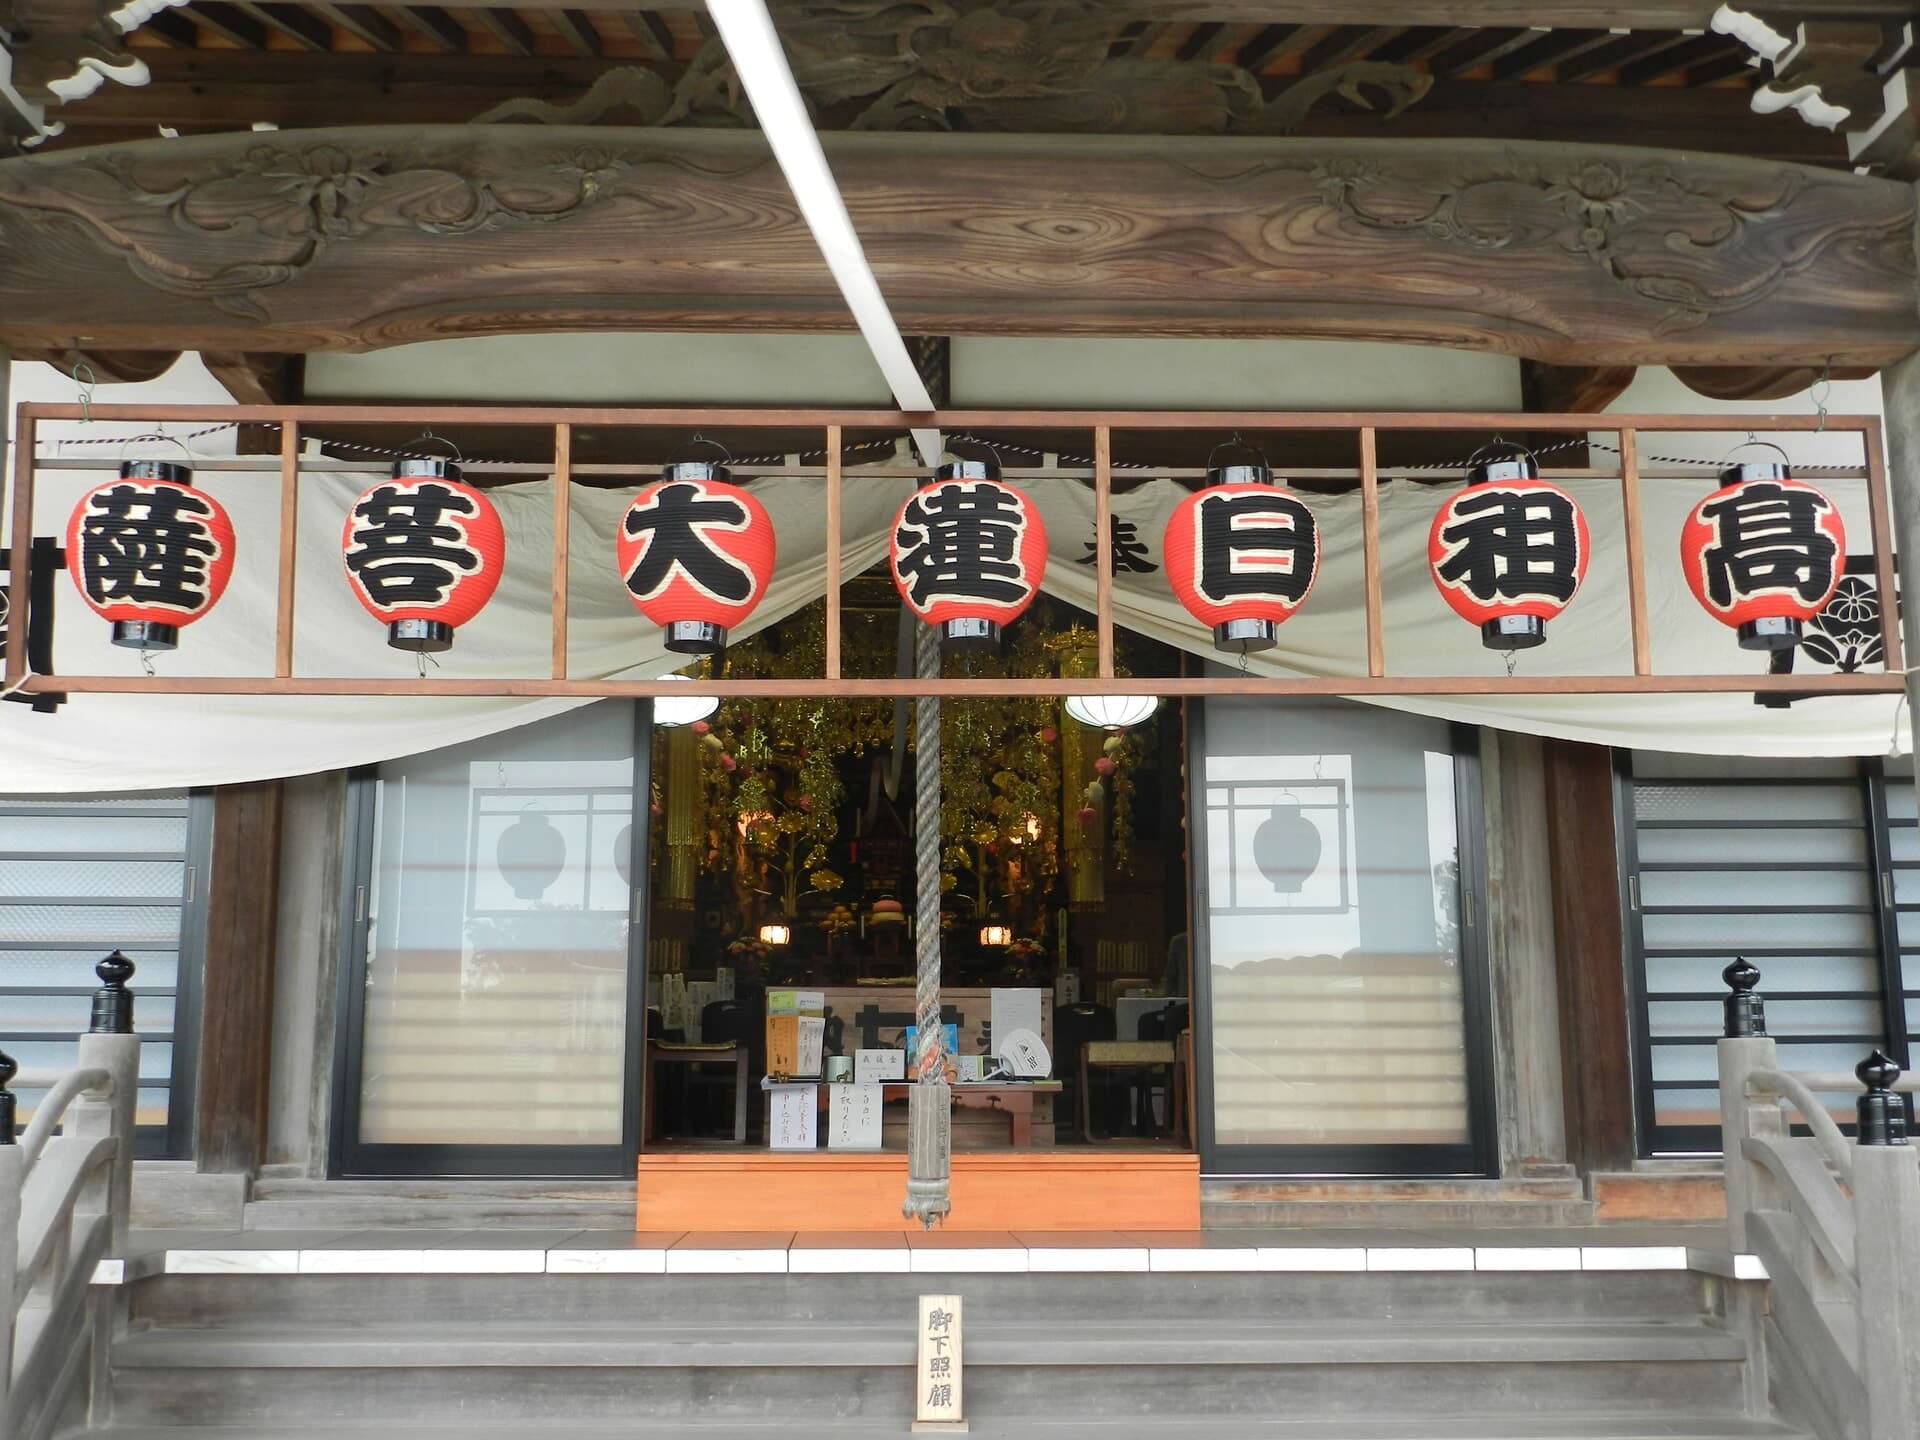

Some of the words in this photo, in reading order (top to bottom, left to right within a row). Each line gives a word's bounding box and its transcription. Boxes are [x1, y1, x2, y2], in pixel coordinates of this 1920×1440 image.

[345, 483, 479, 608] 菩
[624, 483, 753, 603] 大
[895, 483, 1030, 608] 蓮
[1199, 494, 1317, 604] 日
[1436, 490, 1579, 603] 祖
[927, 1308, 953, 1407] 脚下照顧
